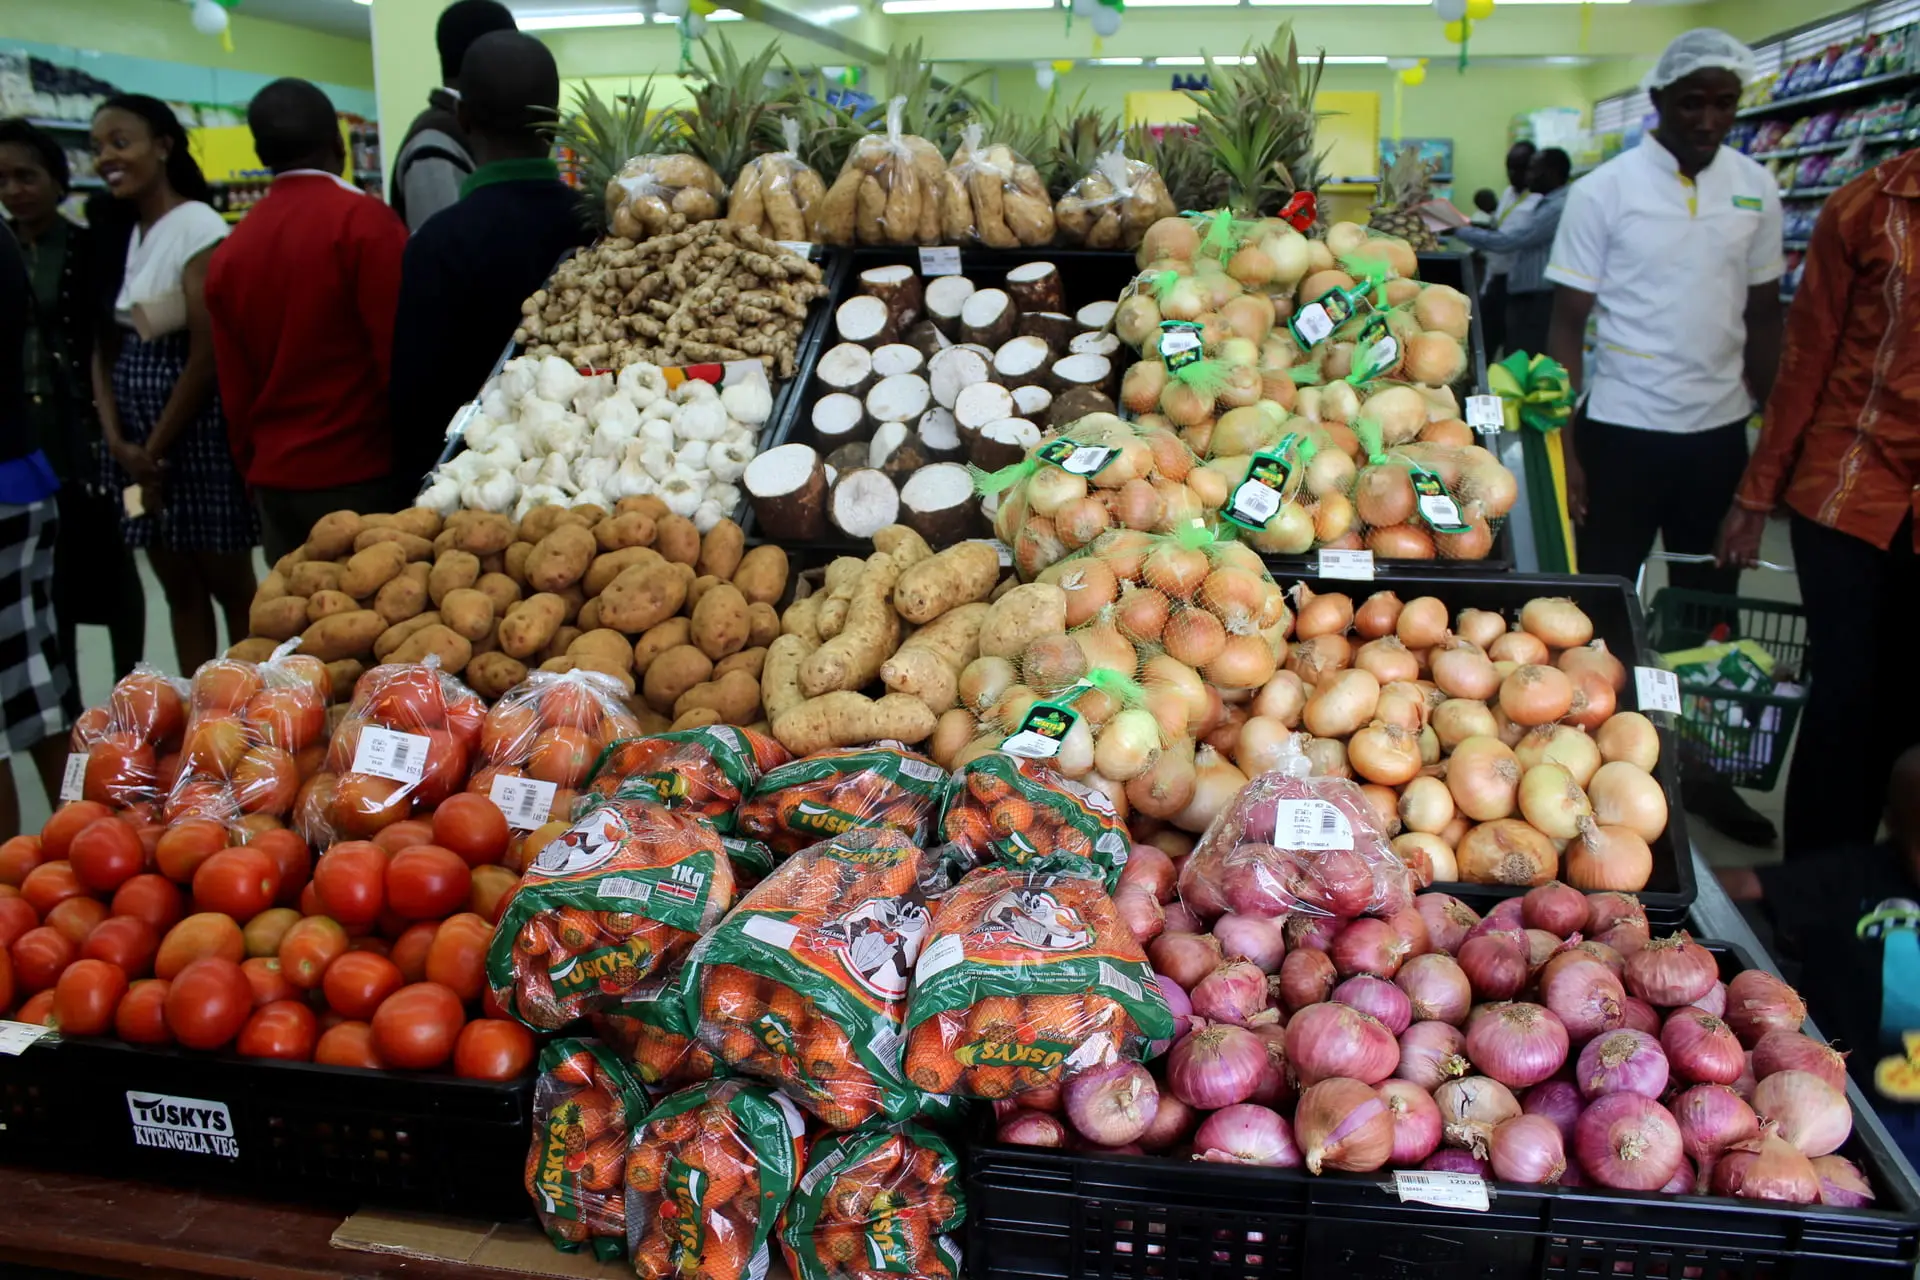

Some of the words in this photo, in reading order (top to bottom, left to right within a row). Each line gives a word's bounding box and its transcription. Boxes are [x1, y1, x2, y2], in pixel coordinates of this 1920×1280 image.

[671, 864, 705, 890] 1Kg
[815, 928, 848, 941] VITAMIN
[982, 932, 996, 945] A
[550, 952, 634, 988] TUSKYS
[981, 1041, 1063, 1071] USKYS
[132, 1098, 228, 1131] TUSKYS
[133, 1125, 211, 1154] KITENGELA
[209, 1135, 240, 1158] VEG
[537, 1122, 568, 1213] TUSKYS
